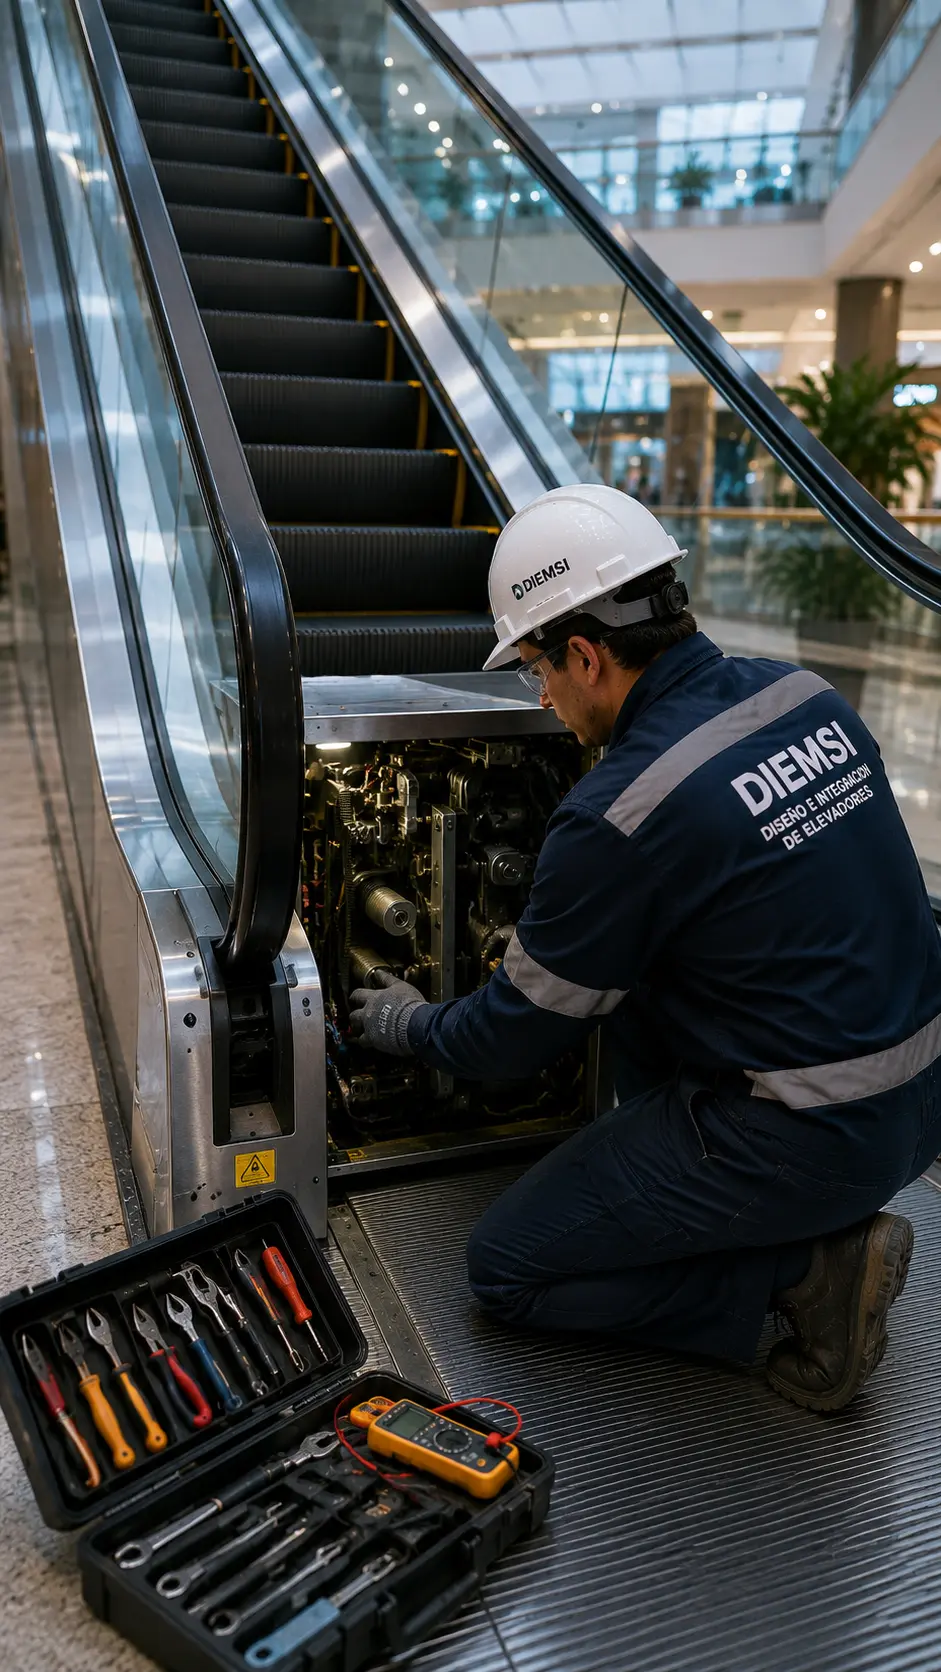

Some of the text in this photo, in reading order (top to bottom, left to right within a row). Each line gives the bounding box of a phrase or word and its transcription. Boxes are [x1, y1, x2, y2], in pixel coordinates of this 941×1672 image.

[522, 558, 570, 593] DIEMSI
[730, 720, 858, 817] DIEMSI
[760, 804, 807, 841] DISEÑO
[805, 797, 818, 812] E
[781, 784, 874, 850] DE ELEVADORES
